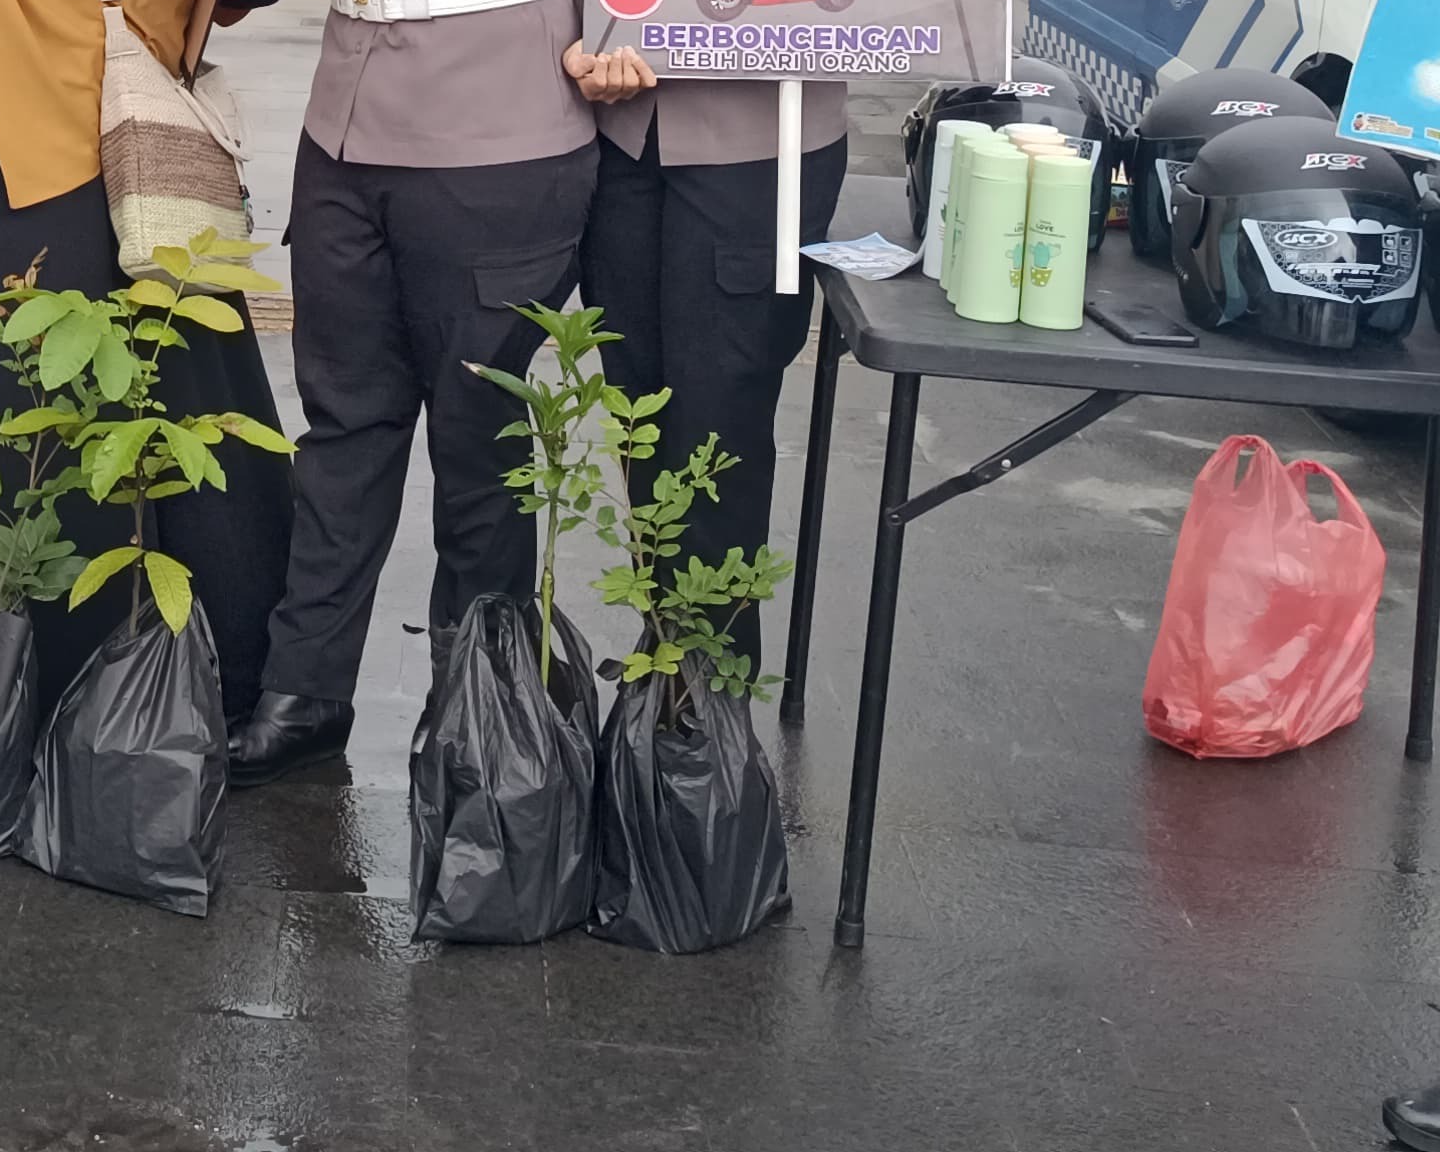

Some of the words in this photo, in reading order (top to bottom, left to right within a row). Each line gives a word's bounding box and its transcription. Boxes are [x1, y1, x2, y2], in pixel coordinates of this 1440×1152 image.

[642, 24, 940, 53] BERBONCENGAN
[670, 51, 736, 69] LEBIH
[744, 52, 799, 70] DARI
[805, 52, 815, 71] 1
[822, 53, 909, 72] ORANG
